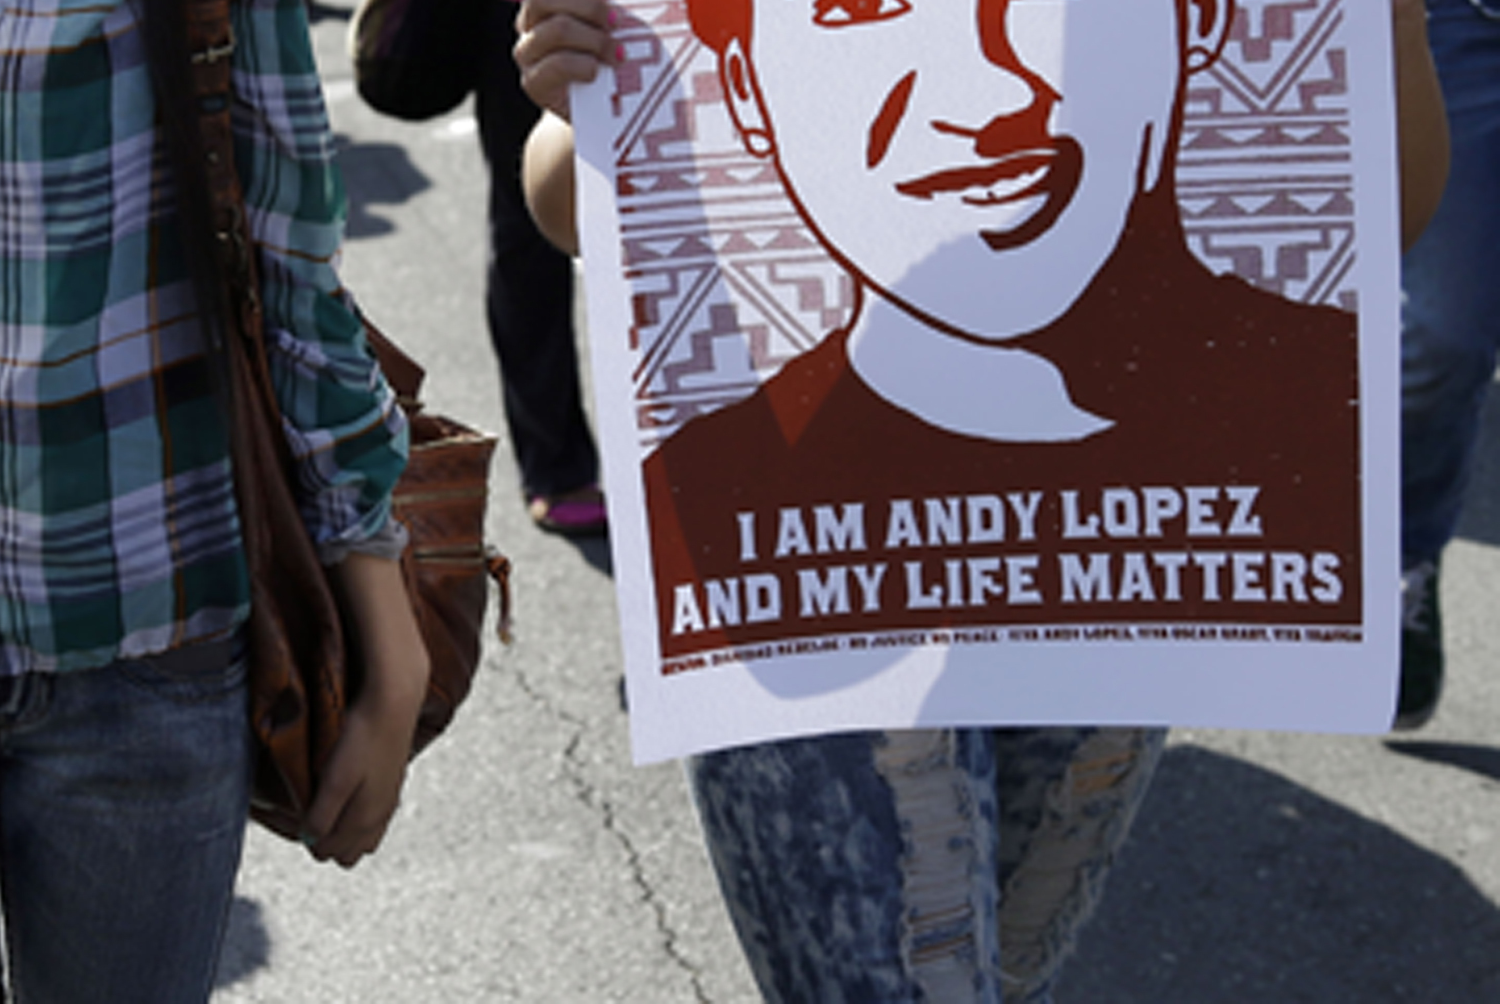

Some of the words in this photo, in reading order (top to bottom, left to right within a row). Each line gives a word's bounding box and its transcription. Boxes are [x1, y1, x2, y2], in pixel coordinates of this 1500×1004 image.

[737, 512, 757, 561] I
[774, 502, 867, 558] AM
[886, 491, 1043, 548] ANDY
[1060, 486, 1264, 539] LOPEZ
[672, 573, 781, 635] AND
[797, 562, 887, 618] MY
[904, 554, 1043, 609] LIFE
[1058, 551, 1343, 603] MATTERS
